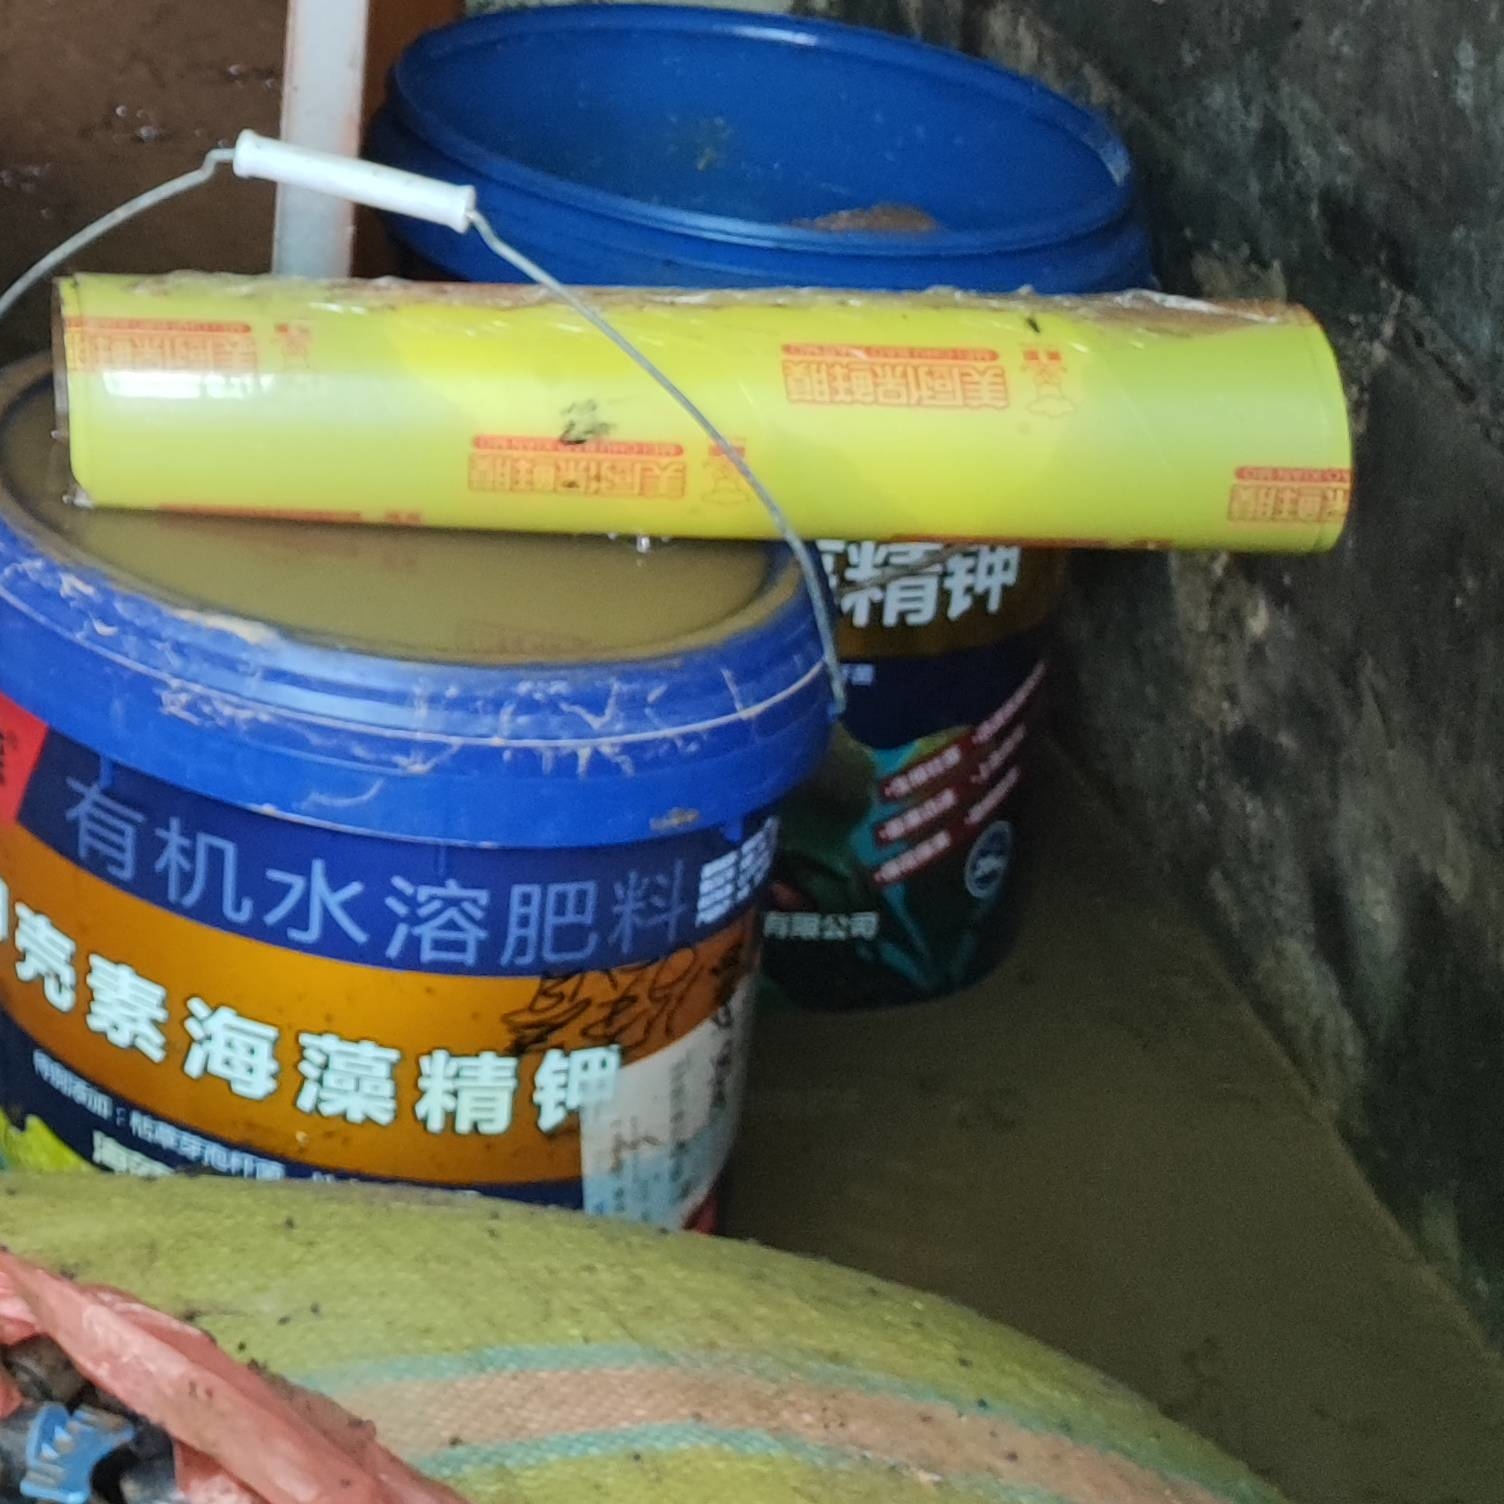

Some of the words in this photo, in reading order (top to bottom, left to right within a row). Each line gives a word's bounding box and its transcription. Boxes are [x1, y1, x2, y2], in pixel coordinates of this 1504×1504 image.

[782, 360, 1010, 409] 美厨保鲜膜
[468, 453, 687, 501] 美厨保鲜膜
[65, 775, 686, 968] 有机水溶肥料
[763, 910, 879, 941] 有限公司
